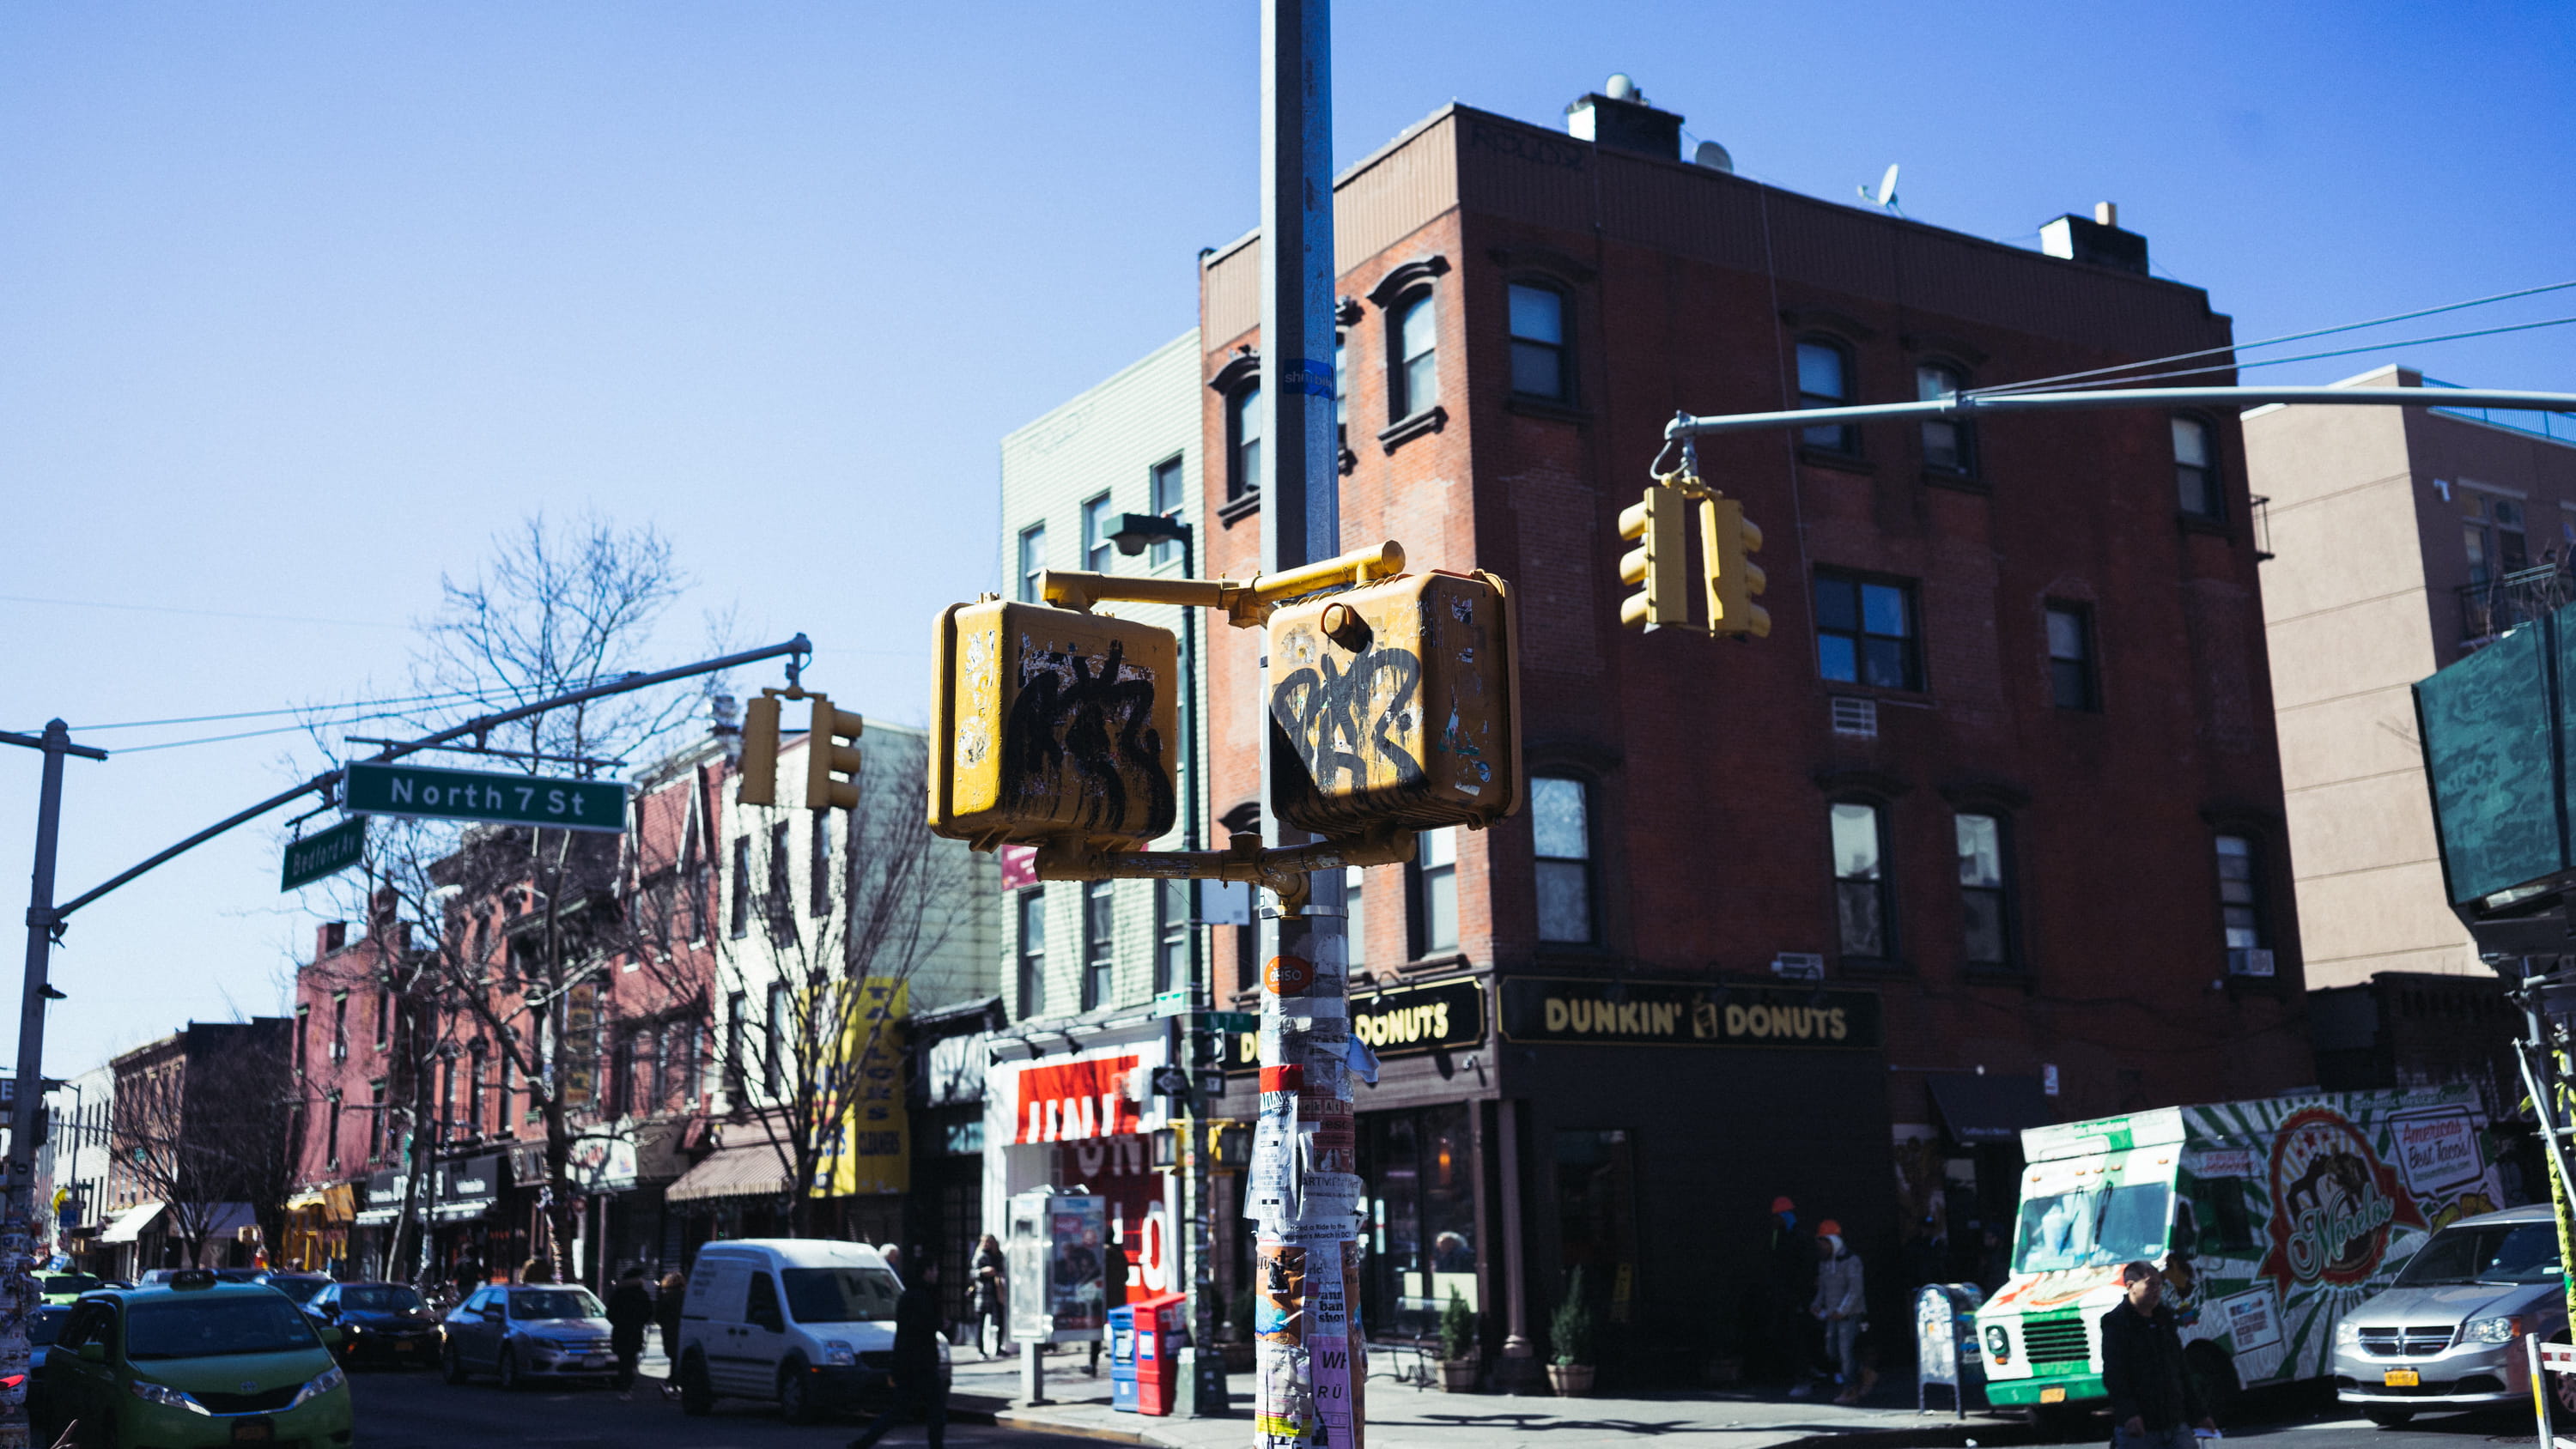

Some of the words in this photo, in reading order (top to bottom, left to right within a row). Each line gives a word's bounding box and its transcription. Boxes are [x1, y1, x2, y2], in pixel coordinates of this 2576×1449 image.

[391, 777, 502, 809] North
[515, 786, 535, 812] 7
[548, 789, 585, 816] St
[292, 838, 340, 877] Bedford
[340, 832, 356, 858] Av
[1355, 1002, 1449, 1046] DONUTS
[1545, 997, 1682, 1035] DUNKIN'
[1725, 1003, 1846, 1040] DONUTS
[2287, 1182, 2395, 1279] Morelos
